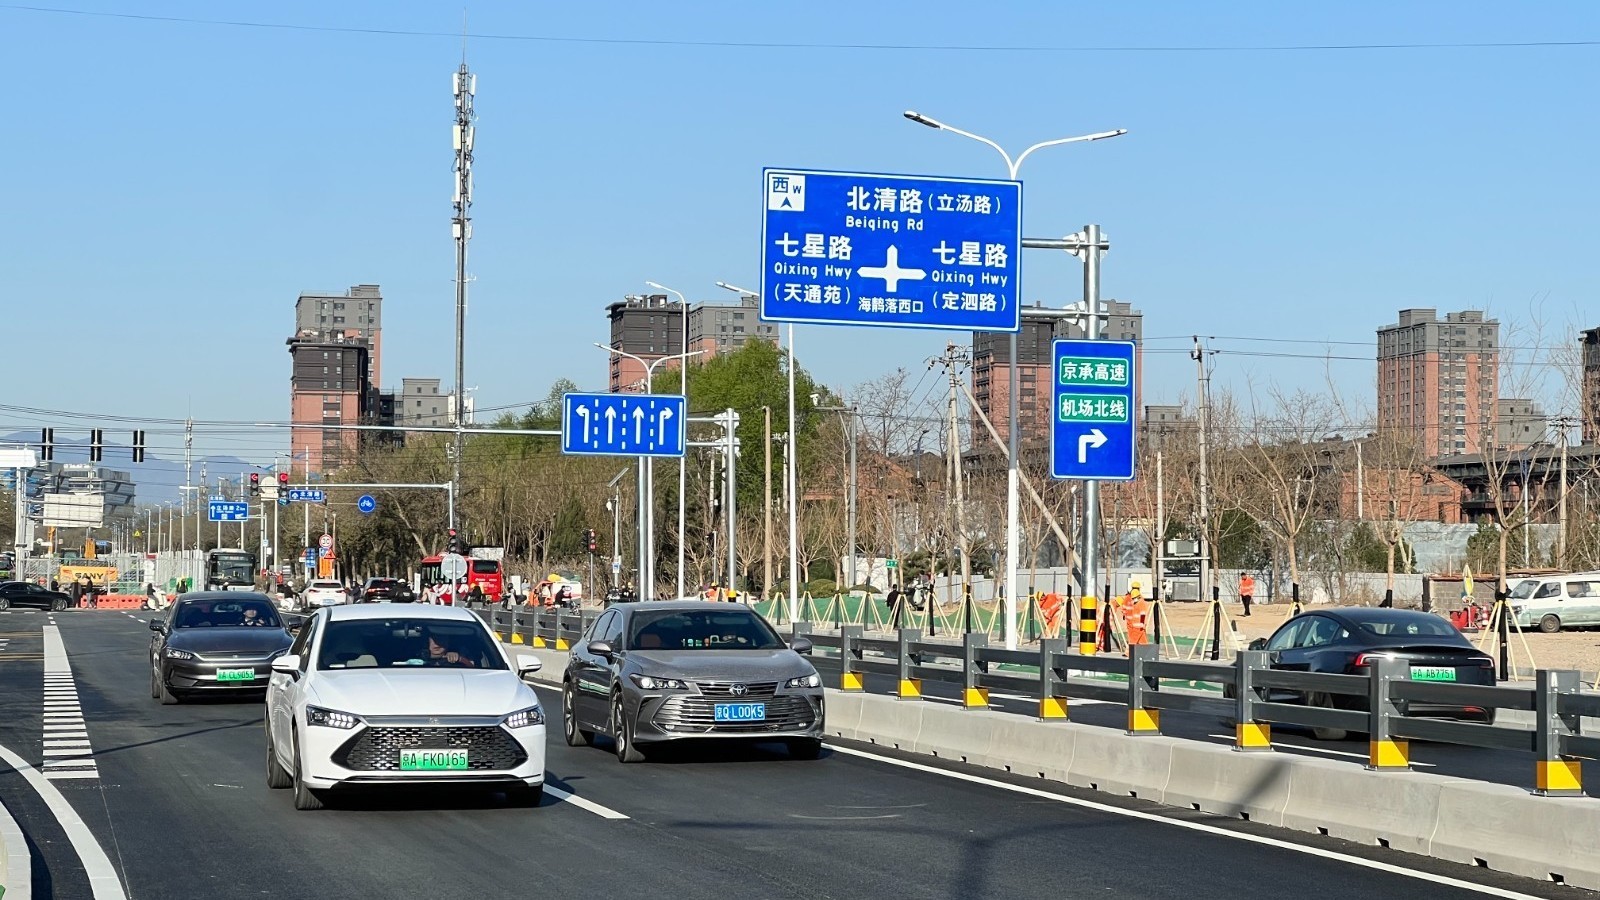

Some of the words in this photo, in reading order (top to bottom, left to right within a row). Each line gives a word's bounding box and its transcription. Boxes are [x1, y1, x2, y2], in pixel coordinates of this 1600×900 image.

[772, 176, 789, 193] 西
[792, 185, 802, 194] W
[846, 186, 923, 214] 北清路
[845, 215, 899, 233] Beiqing
[907, 218, 924, 231] Rd
[774, 232, 853, 261] 七星路
[932, 240, 1008, 269] 七星路
[774, 262, 818, 279] Qixing
[825, 264, 852, 280] Hwy
[931, 269, 974, 287] Qixing
[981, 272, 1008, 288] Hwy
[1062, 362, 1126, 382] 京承高速
[1061, 398, 1126, 419] 机场北线
[74, 572, 104, 580] SANY
